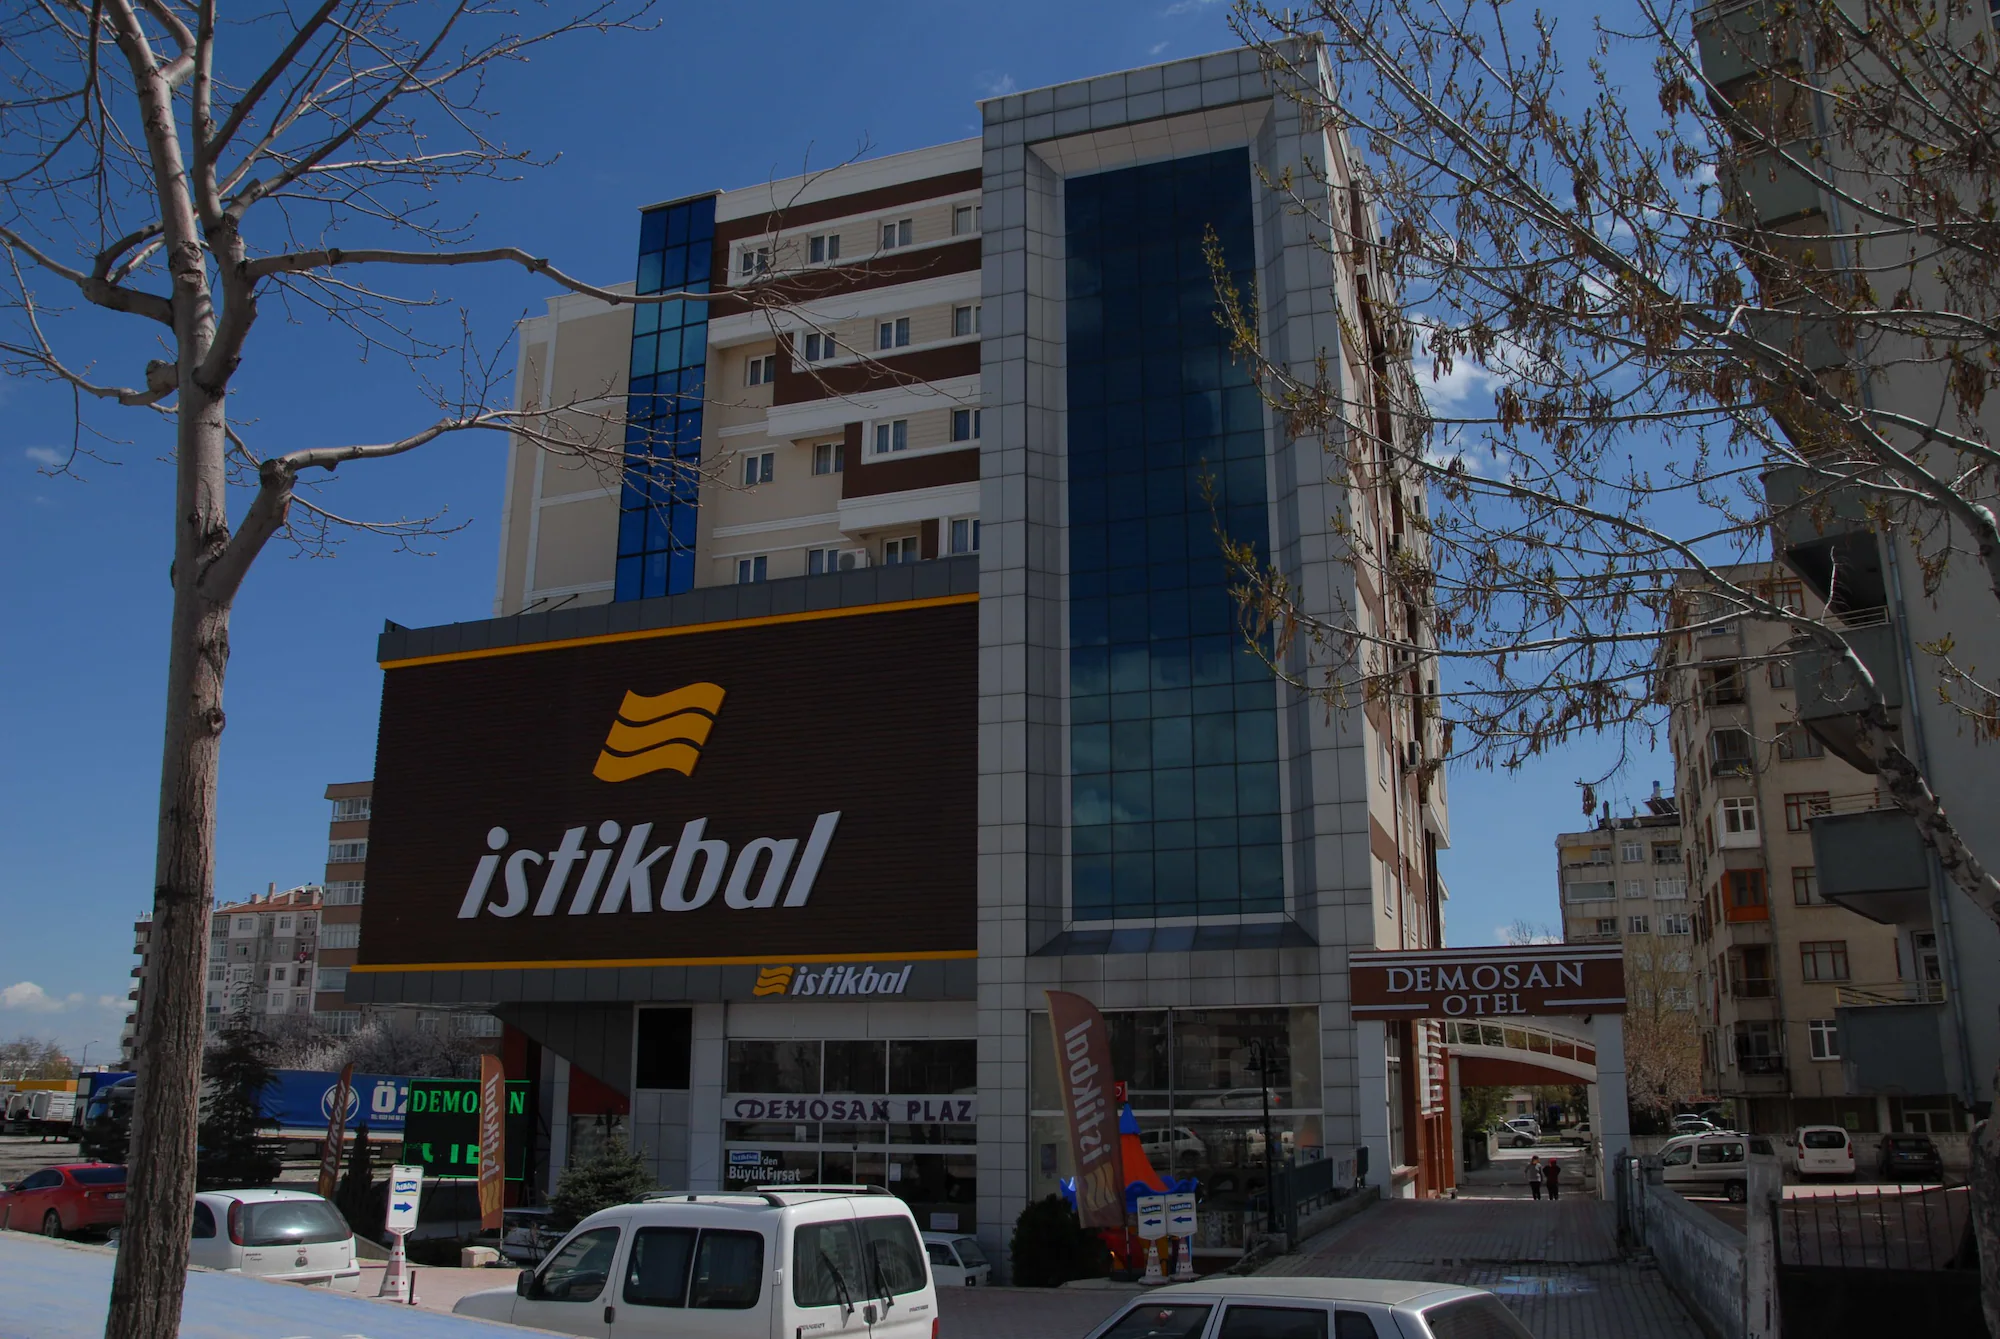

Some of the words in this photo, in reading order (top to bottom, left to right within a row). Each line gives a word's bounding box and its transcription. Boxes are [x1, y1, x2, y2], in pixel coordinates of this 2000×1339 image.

[457, 810, 843, 919] istikbal
[791, 964, 913, 996] istikbal
[1386, 962, 1584, 993] DEMOSAN
[1442, 993, 1527, 1016] OTEL
[412, 1090, 526, 1115] DEMON
[734, 1099, 890, 1121] DEMOSAN
[907, 1100, 977, 1122] PLAZ
[729, 1165, 766, 1182] Büyük
